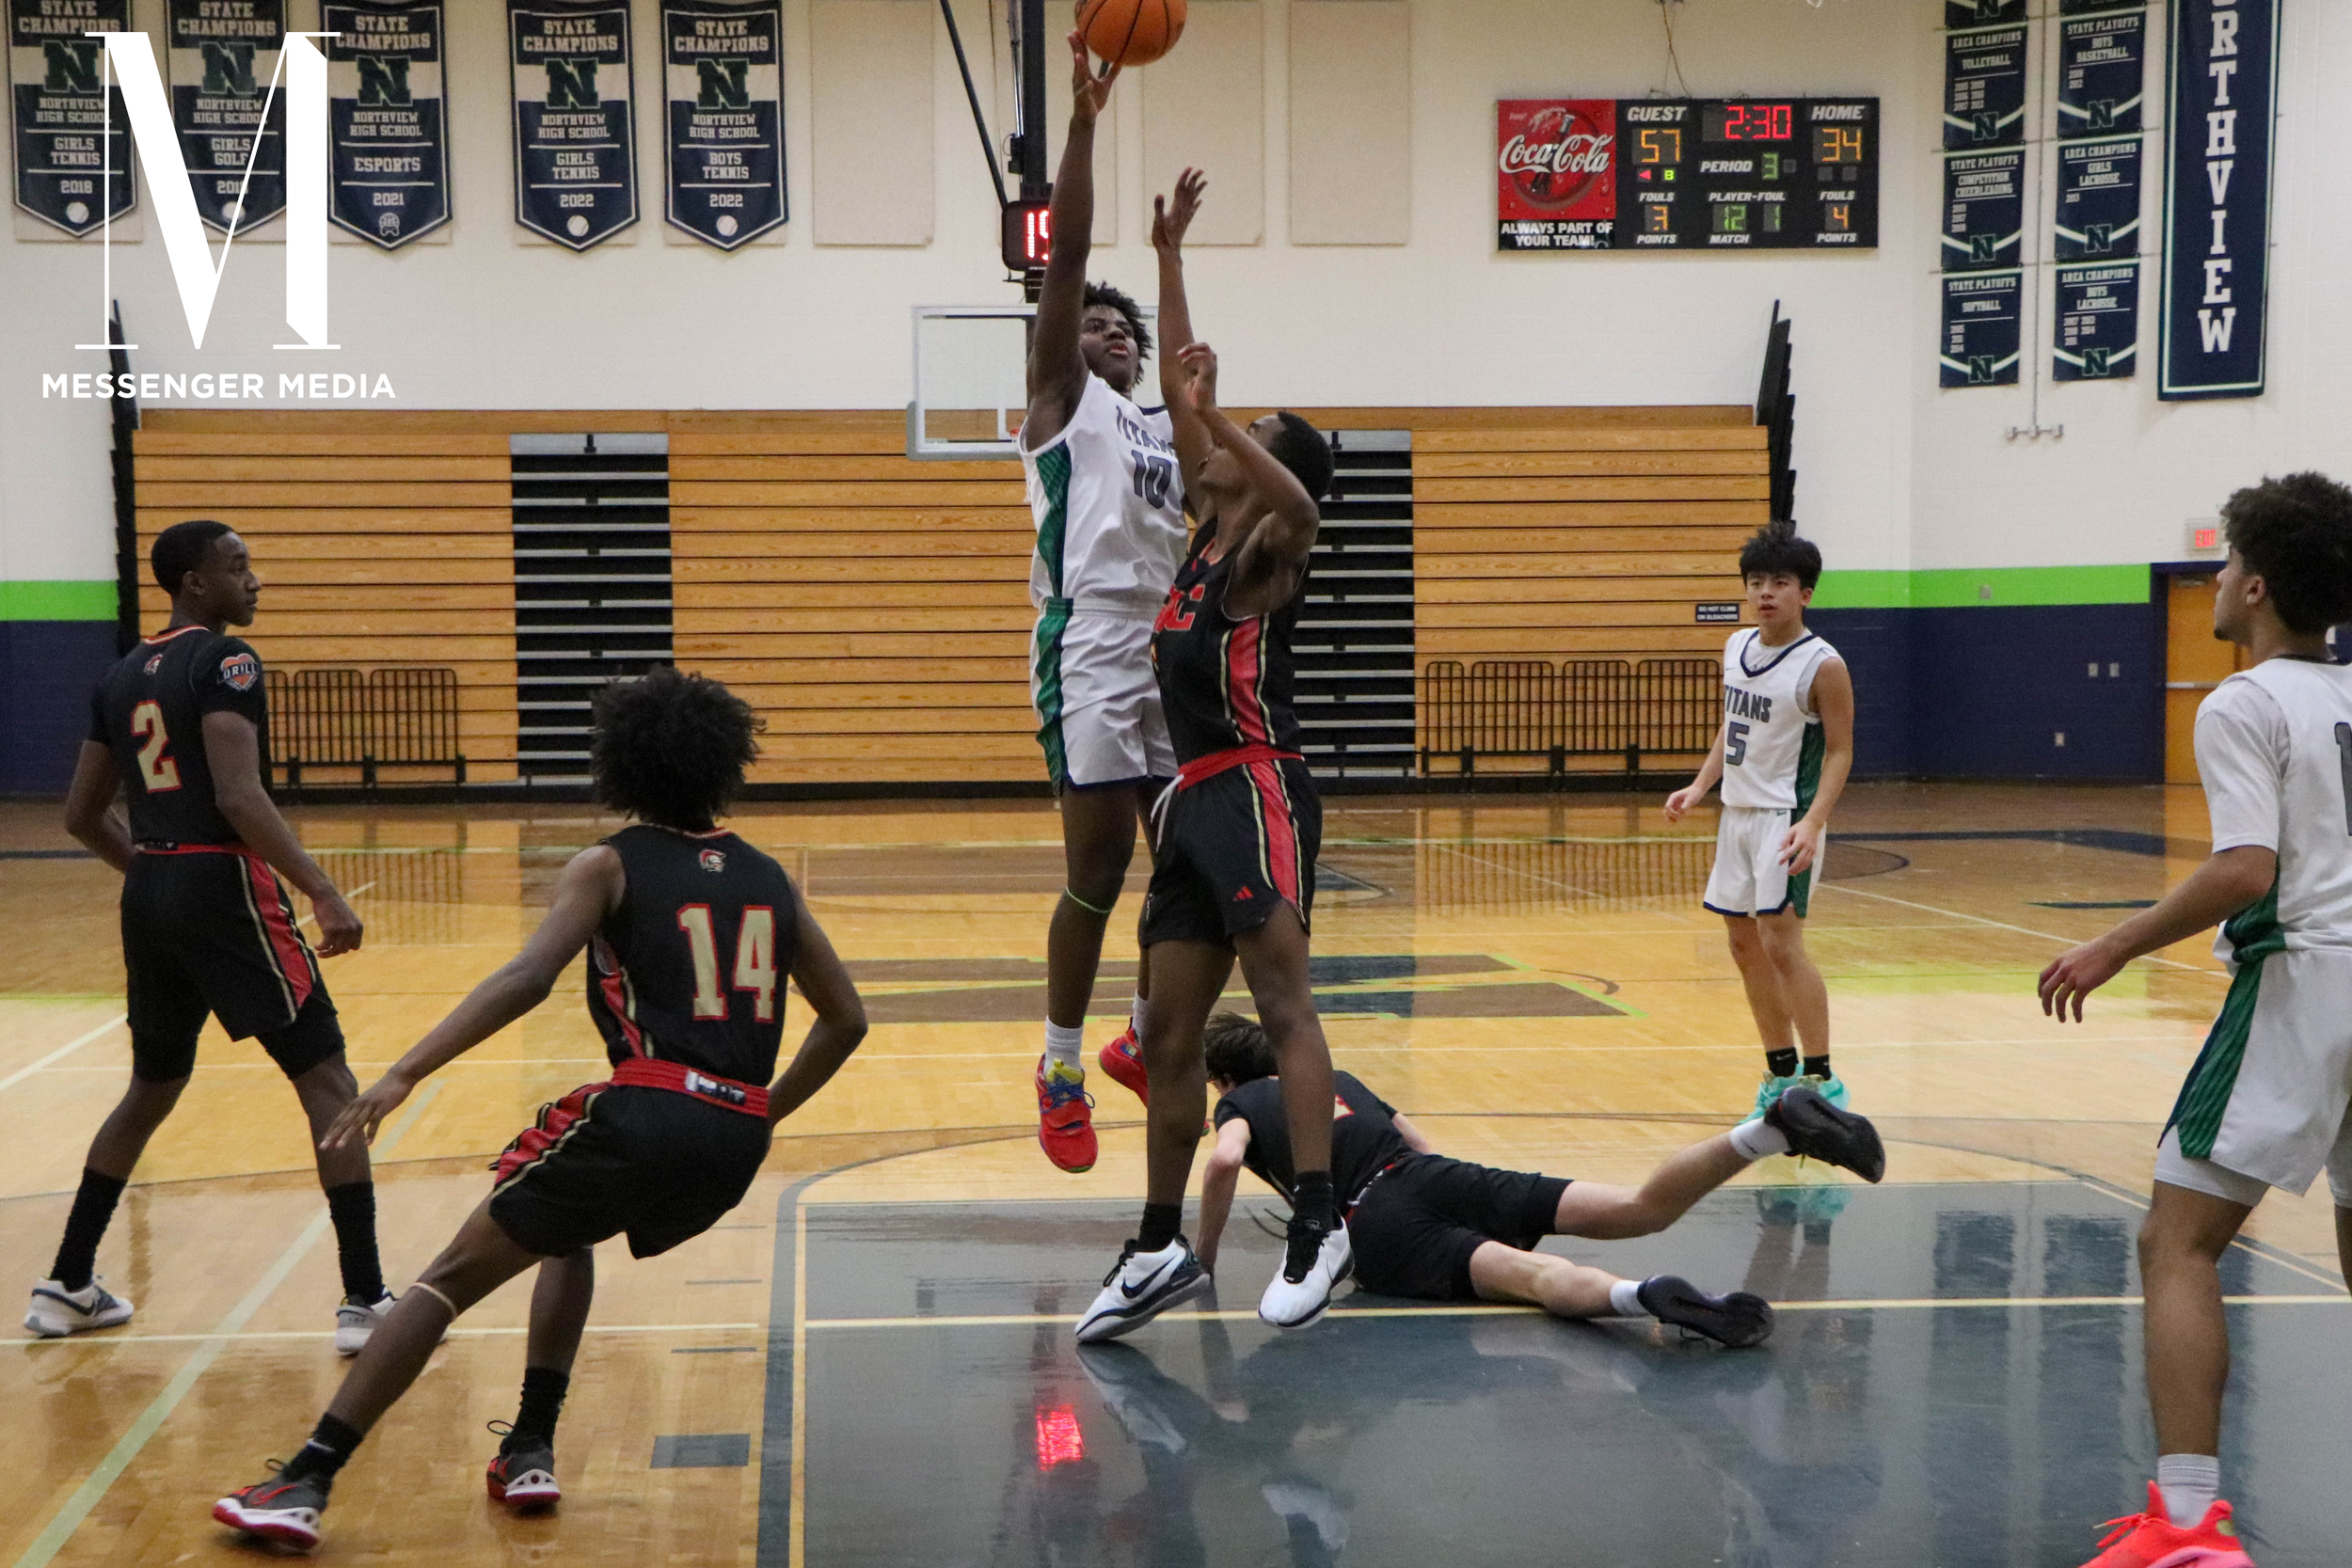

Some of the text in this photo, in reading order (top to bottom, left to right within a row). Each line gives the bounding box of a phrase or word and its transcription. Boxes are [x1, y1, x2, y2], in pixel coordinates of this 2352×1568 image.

[40, 0, 98, 16] STATE
[199, 2, 254, 17] STATE
[19, 17, 121, 34] CHAMPIONS
[177, 19, 277, 36] CHAMPIONS
[356, 15, 409, 32] STATE
[544, 19, 596, 35] STATE
[695, 20, 748, 36] STATE
[2068, 16, 2139, 35] STATE PLAYOFFS
[335, 32, 431, 50] CHAMPIONS
[523, 35, 618, 53] CHAMPIONS
[675, 36, 769, 53] CHAMPIONS
[1952, 30, 2022, 49] AREA CHAMPIONS
[42, 40, 102, 93] N
[199, 41, 257, 94] N
[356, 54, 413, 107] N
[544, 57, 600, 109] N
[695, 57, 751, 109] N
[39, 98, 106, 110] NORTHVIEW
[196, 99, 263, 111] NORTHVIEW
[36, 111, 112, 123] HIGH SCHOO
[193, 112, 221, 123] HIGH
[353, 111, 419, 123] NORTHVIEW
[541, 114, 606, 126] NORTHVIEW
[692, 114, 755, 126] NORTHVIEW
[1627, 106, 1687, 121] GUEST
[1811, 105, 1866, 120] HOME
[1724, 104, 1792, 140] 2:30
[350, 124, 423, 136] HIGH SCHOOL
[538, 127, 611, 139] HIGH SCHOOL
[689, 127, 760, 139] HIGH SCHOOL
[55, 137, 95, 150] GIRLS
[212, 138, 251, 151] GIRLS
[1641, 129, 1681, 163] 57
[1821, 127, 1862, 162] 34
[2064, 142, 2137, 160] AREA CHAMPIONS
[50, 151, 101, 166] TENNIS
[215, 152, 248, 166] GOLF
[556, 152, 595, 166] GIRLS
[709, 152, 742, 166] BOYS
[1499, 134, 1613, 174] Coca-Cola
[354, 156, 421, 172] ESPORTS
[1700, 160, 1754, 173] PERIOD
[1762, 152, 1779, 181] 3
[1950, 154, 2019, 170] STATE PLAYOFFS
[2087, 161, 2112, 174] GIRLS
[552, 166, 599, 180] TENNIS
[703, 166, 750, 180] TENNIS
[1663, 169, 1675, 181] B
[2198, 0, 2238, 353] RTHVIEW
[60, 180, 93, 195] 2018
[1820, 190, 1855, 200] FOULS
[373, 192, 405, 206] 2021
[560, 194, 594, 208] 2022
[709, 194, 743, 208] 2022
[1639, 192, 1675, 202] FOULS
[1708, 191, 1787, 202] PLAYER-FOUL
[1724, 205, 1748, 231] 12
[1774, 205, 1781, 230] 1
[1832, 205, 1850, 230] 4
[1501, 222, 1613, 234] ALWAYS PART OF
[1516, 234, 1595, 246] YOUR TEAM!
[1636, 234, 1677, 245] POINTS
[1709, 234, 1751, 245] MATCH
[1817, 232, 1858, 244] POINTS
[2061, 267, 2134, 283] AREA CHAMPIONS
[1948, 277, 2016, 292] STATE PLAYOFFS
[1131, 450, 1172, 510] 10
[2195, 530, 2217, 547] EXIT
[130, 699, 183, 795] 2
[1725, 721, 1750, 767] 5
[675, 902, 778, 1024] 14
